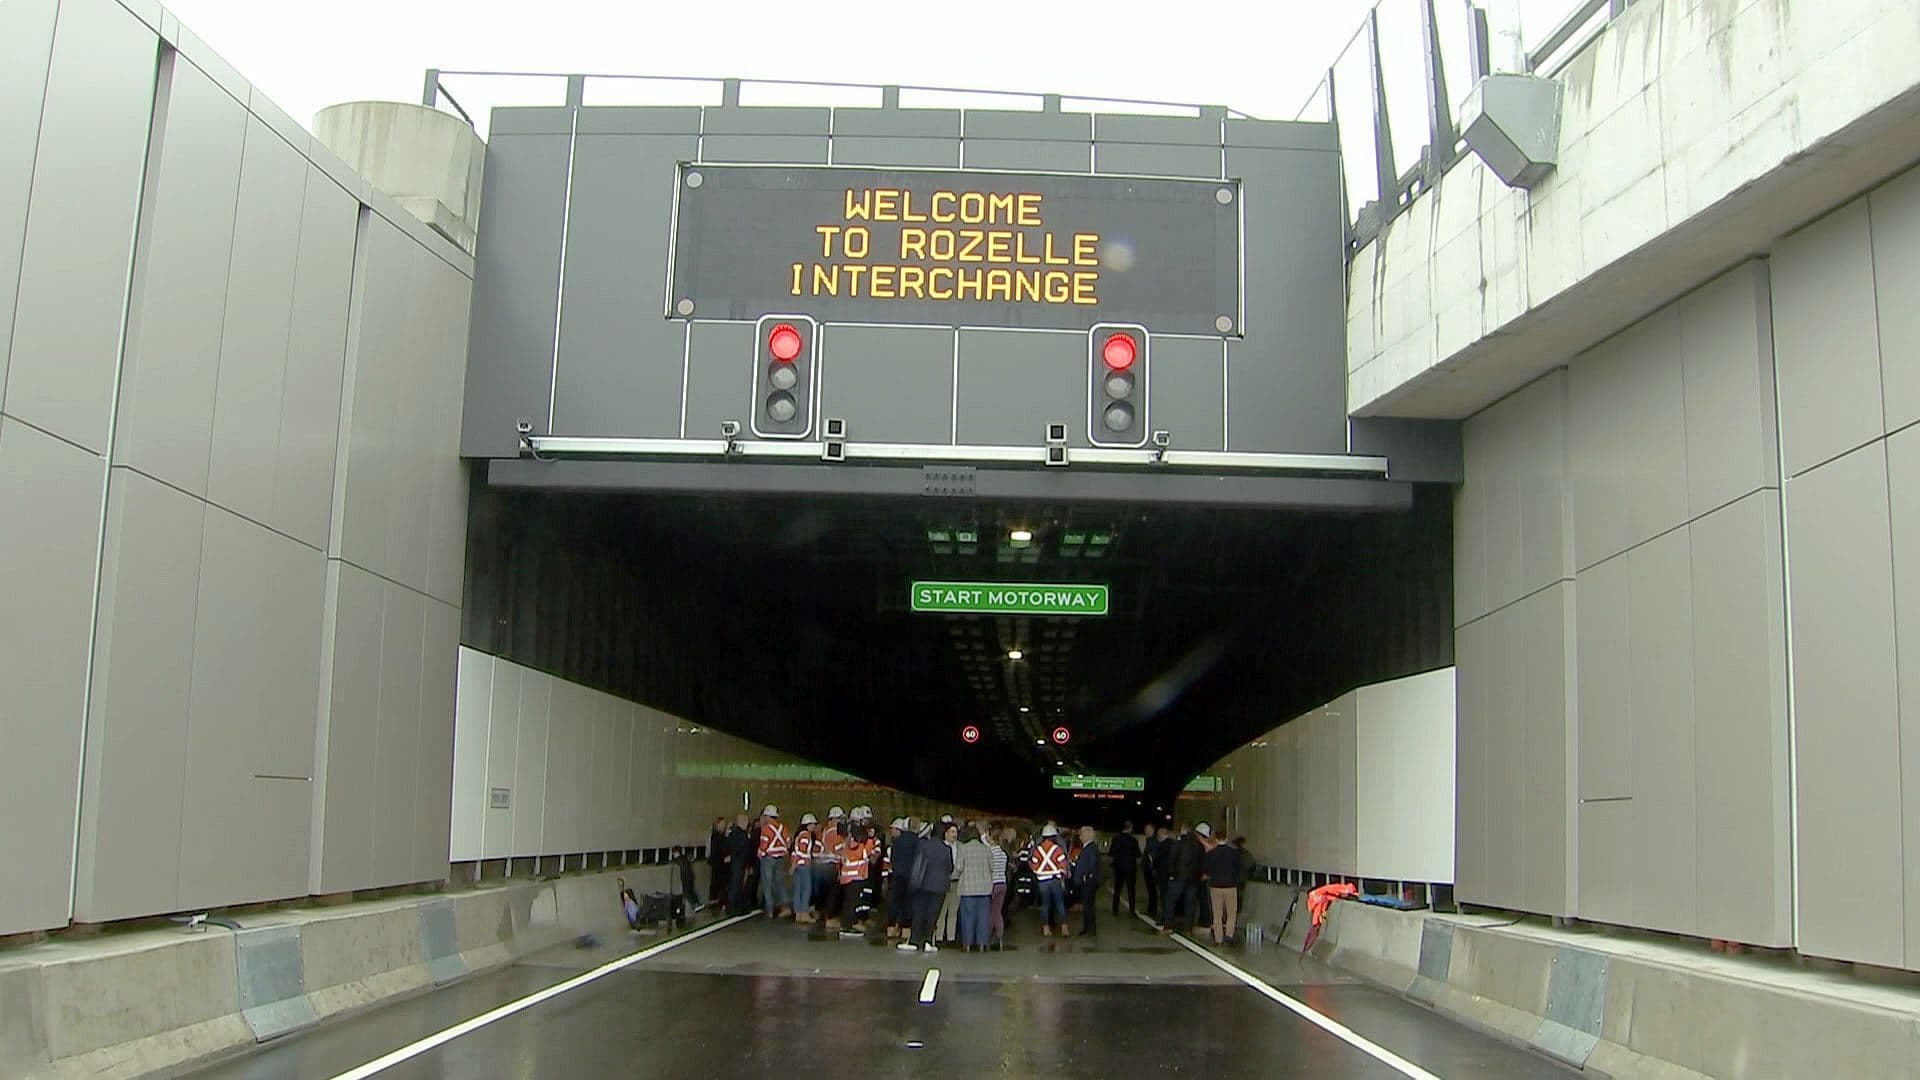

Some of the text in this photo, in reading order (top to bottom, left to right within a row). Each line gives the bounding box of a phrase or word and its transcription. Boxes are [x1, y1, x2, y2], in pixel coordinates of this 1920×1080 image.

[845, 189, 1042, 226] WELCOME
[816, 226, 1099, 267] TO ROZELLE
[791, 264, 1098, 304] INTERCHANGE
[919, 589, 1100, 607] START MOTORWAY
[965, 729, 976, 739] 60
[1056, 731, 1067, 740] 60
